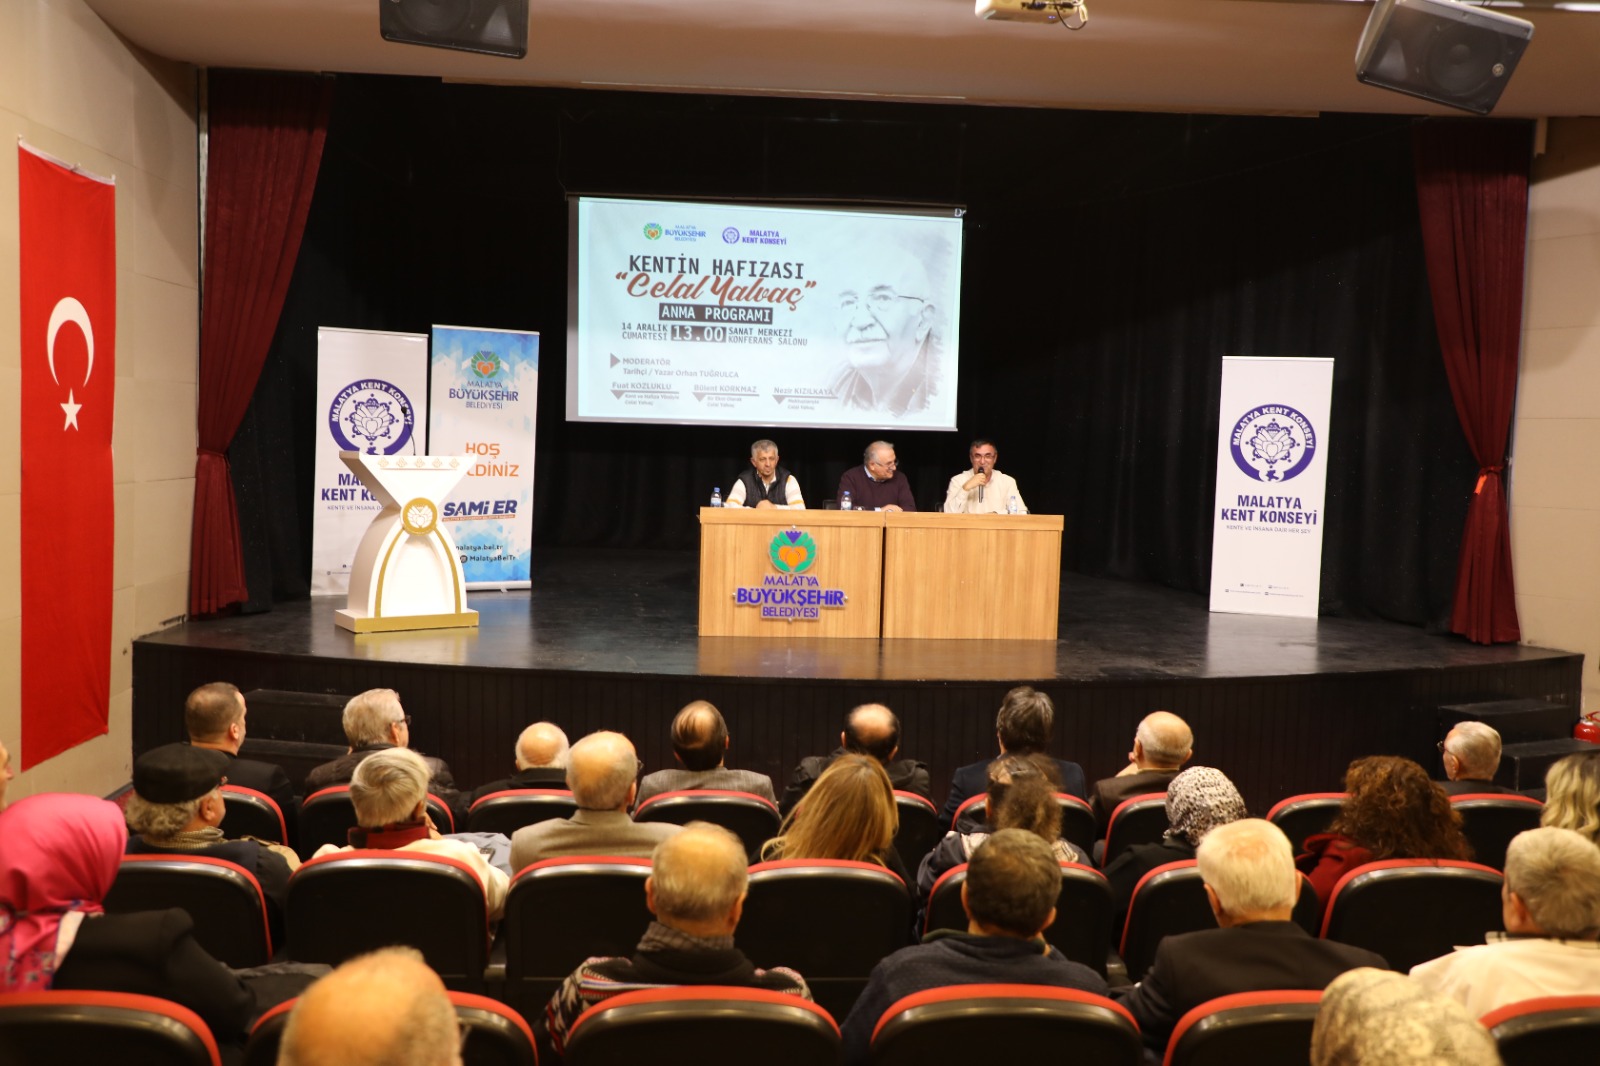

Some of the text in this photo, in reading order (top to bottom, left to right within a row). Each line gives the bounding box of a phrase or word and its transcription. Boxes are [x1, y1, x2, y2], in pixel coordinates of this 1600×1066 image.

[750, 230, 779, 238] MALATYA
[629, 253, 804, 279] KENTİN HAFIZASI
[661, 306, 770, 322] ANMA PROGRAMI
[636, 323, 668, 332] ARALIK
[672, 326, 724, 341] 13.00
[728, 327, 792, 337] SANAT MERKEZİ
[622, 332, 667, 341] CUMARTESİ
[728, 336, 808, 346] KONFERANS SALONU
[623, 368, 647, 376] Tarihçi
[699, 370, 739, 378] TUĞRULCA
[332, 386, 359, 422] MALATYA
[361, 382, 387, 390] KENT
[1233, 411, 1260, 446] MALATYA
[1262, 407, 1290, 415] KENT
[465, 442, 500, 459] HOŞ
[322, 488, 356, 501] KENT
[492, 500, 517, 514] ER
[1237, 495, 1301, 509] MALATYA
[1221, 508, 1317, 525] KENT KONSEYİ
[764, 576, 818, 586] MALATYA
